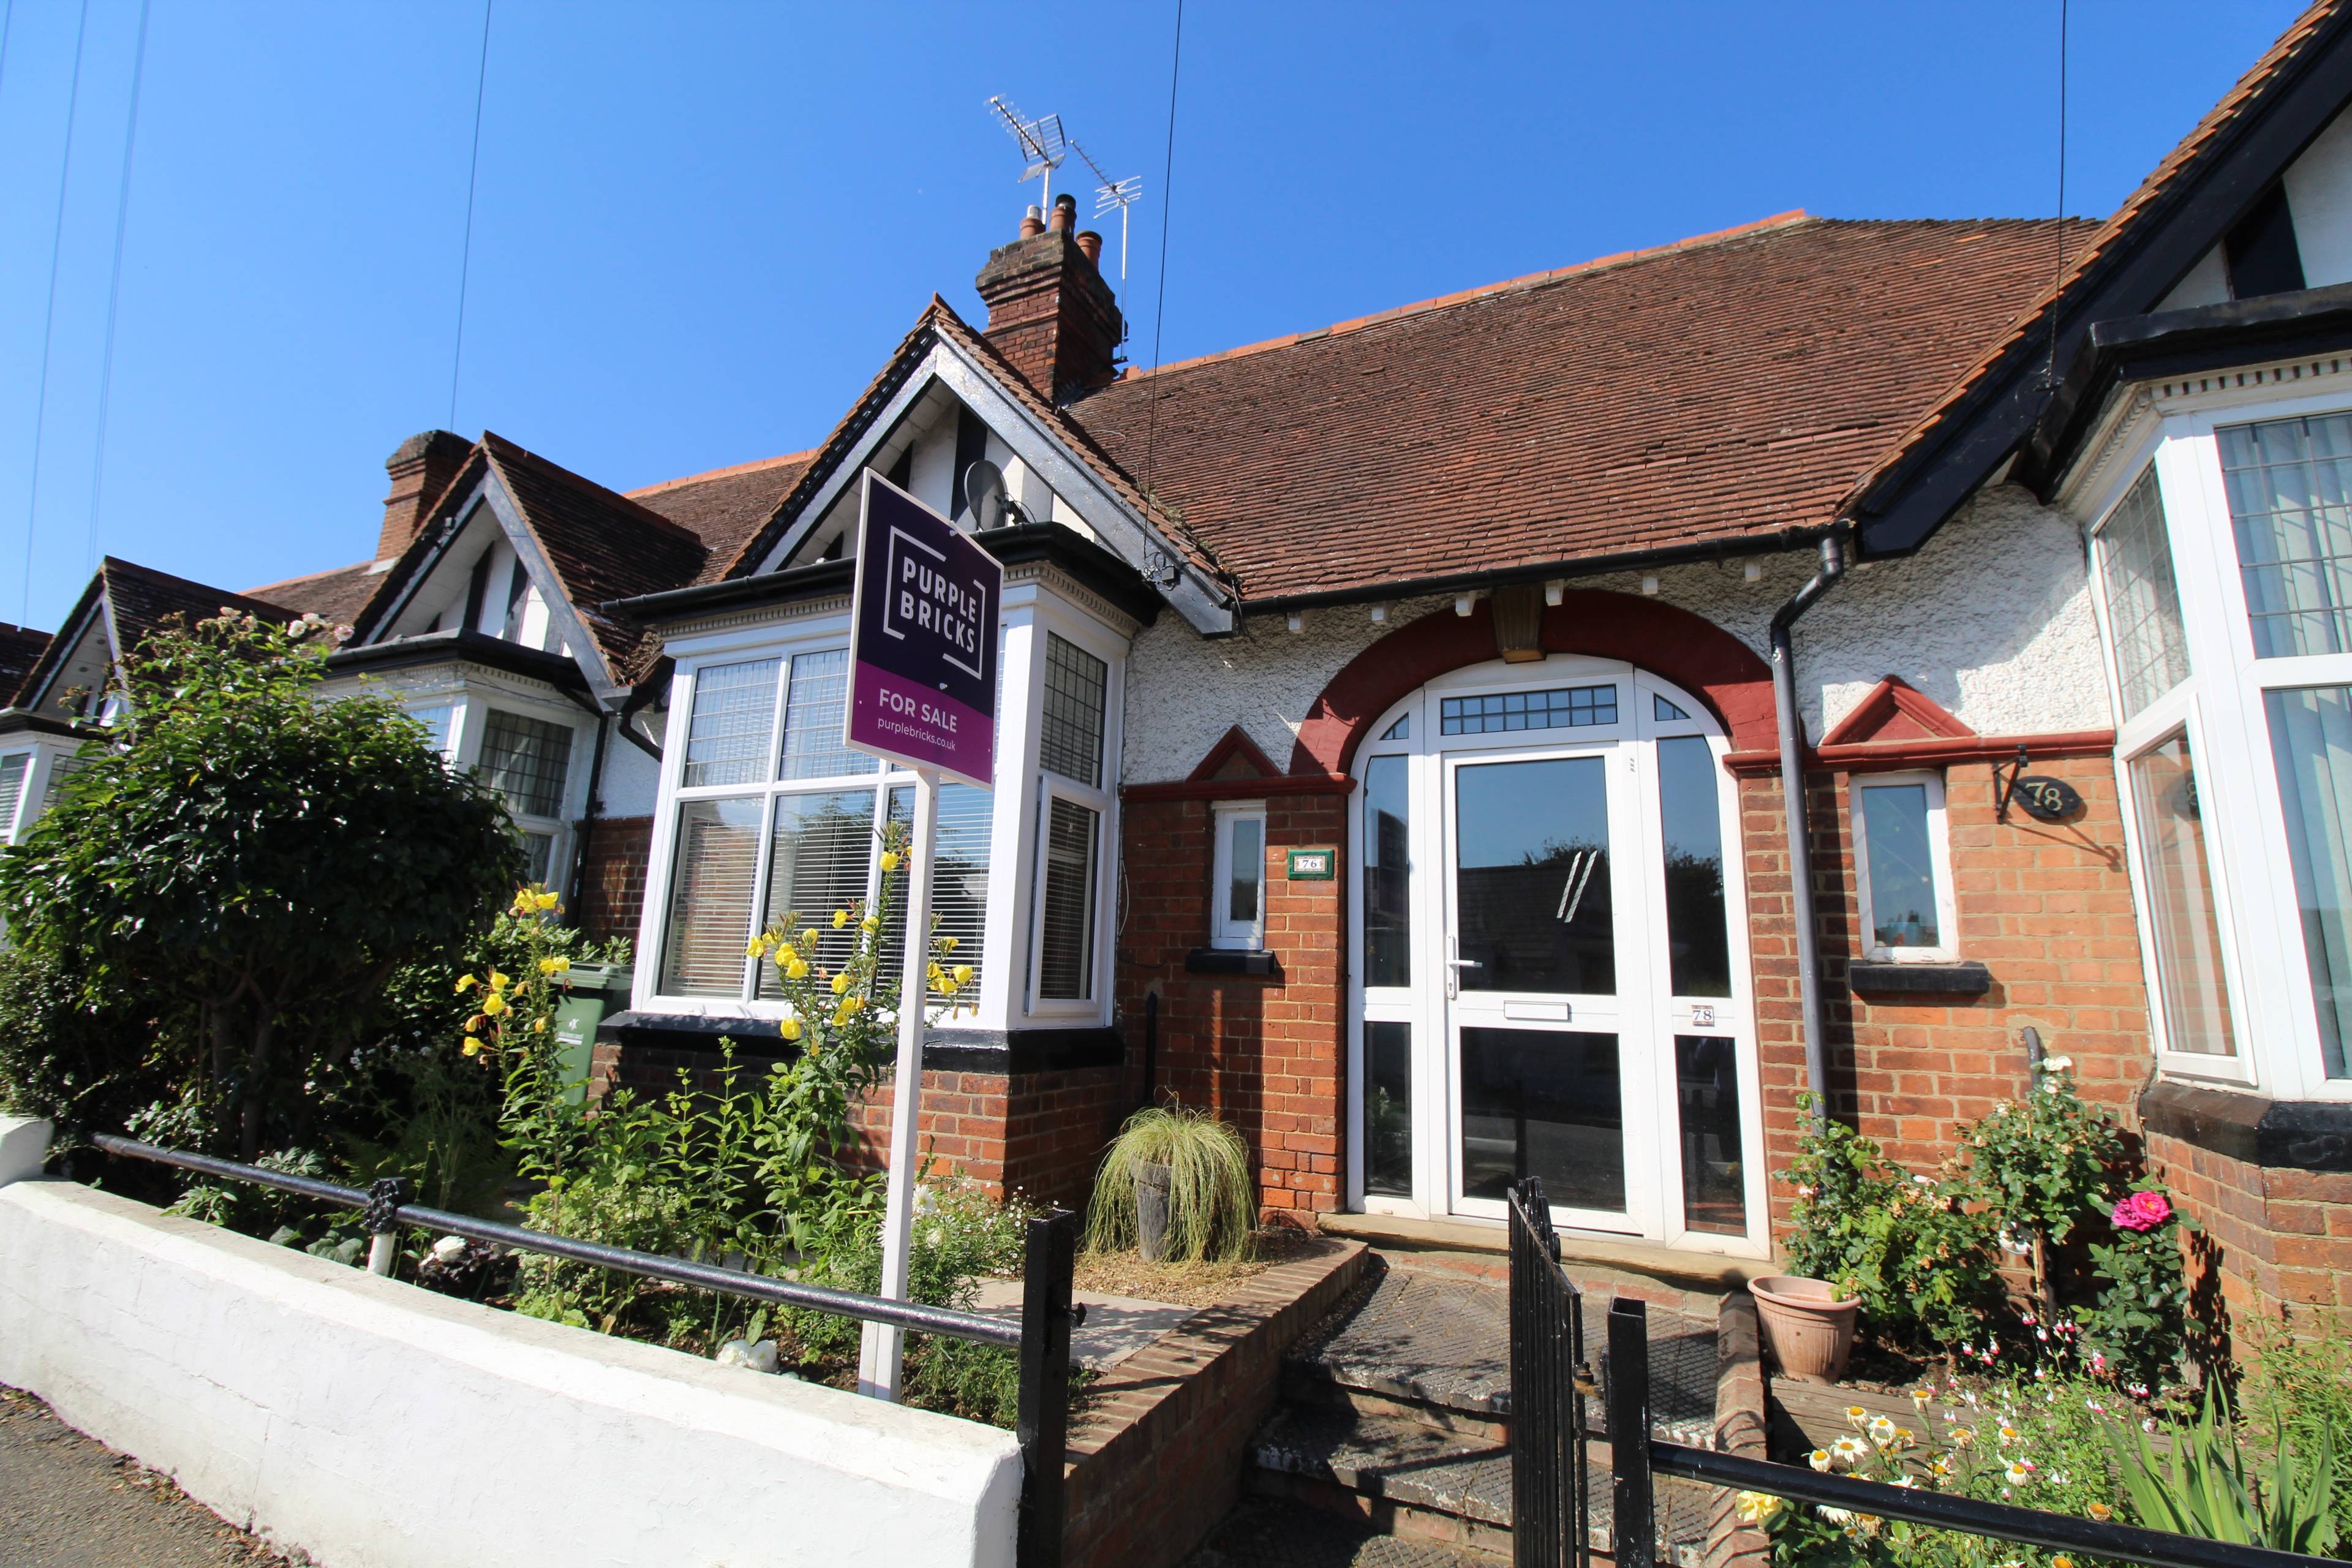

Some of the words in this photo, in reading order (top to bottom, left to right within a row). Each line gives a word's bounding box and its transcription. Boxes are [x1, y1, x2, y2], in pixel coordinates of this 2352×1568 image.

[902, 556, 976, 624] PURPLE
[900, 590, 975, 654] BRICKS
[879, 688, 916, 717] FOR
[921, 704, 957, 734] SALE
[877, 716, 956, 752] purplebricks.co.uk
[2025, 782, 2064, 812] 78
[1303, 859, 1317, 868] 76
[1693, 1010, 1712, 1020] 78
